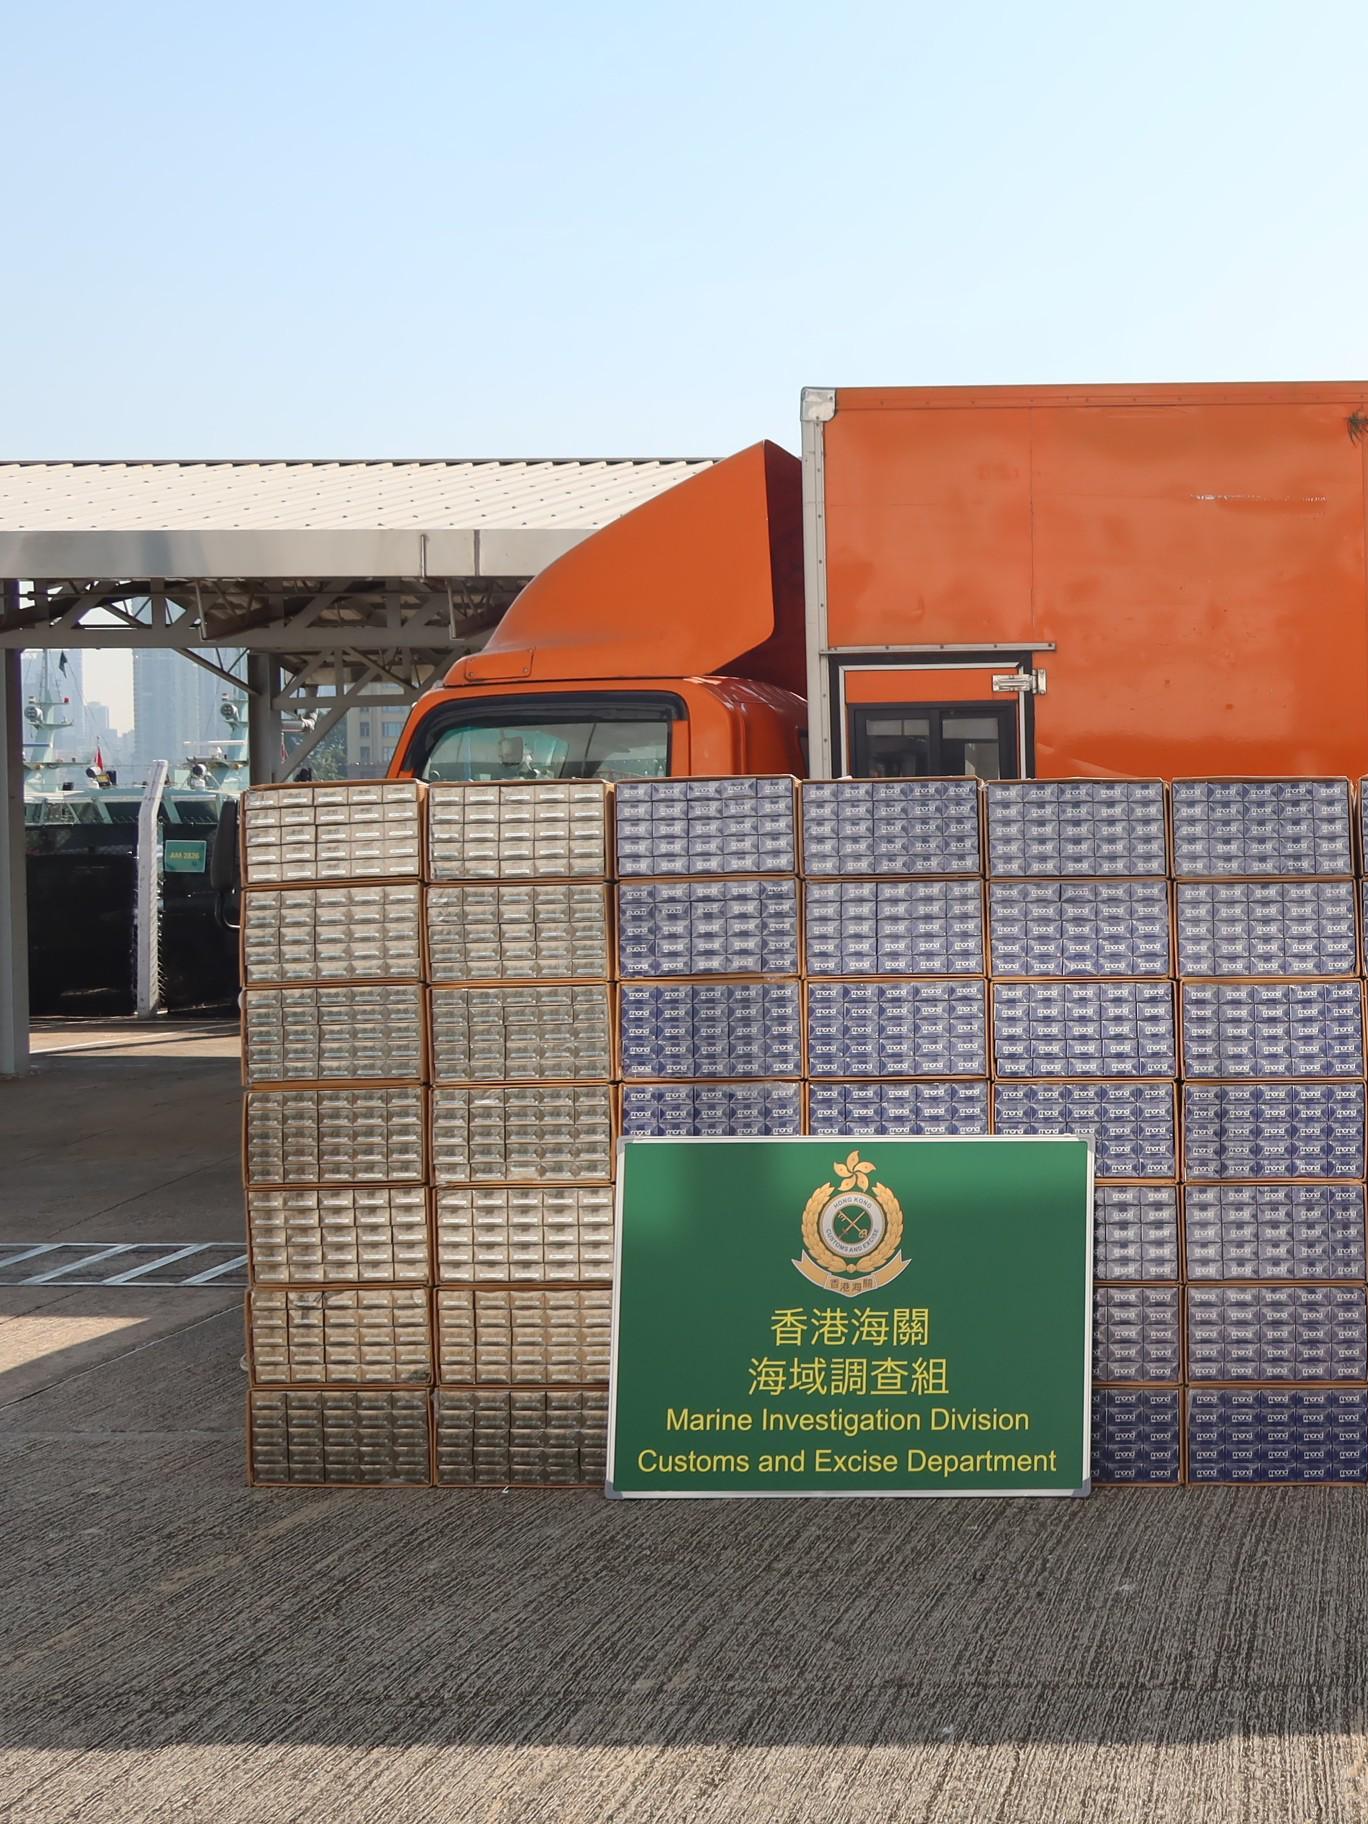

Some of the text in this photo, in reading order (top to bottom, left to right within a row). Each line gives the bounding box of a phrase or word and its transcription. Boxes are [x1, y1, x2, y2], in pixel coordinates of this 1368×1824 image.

[1221, 925, 1242, 933] mond
[919, 941, 940, 949] mond
[920, 960, 941, 968] mond
[1226, 990, 1247, 998] mond
[629, 1009, 650, 1017] mond
[816, 1007, 837, 1015] mond
[816, 1026, 837, 1034] mond
[1002, 1026, 1023, 1034] mond
[1109, 1025, 1130, 1033] mond
[816, 1044, 837, 1052] mond
[1110, 1044, 1131, 1052] mond
[1227, 1045, 1248, 1053] mond
[1300, 1063, 1321, 1071] mond
[852, 1089, 873, 1097] mond
[1038, 1090, 1059, 1098] mond
[1335, 1090, 1356, 1098] mond
[701, 1109, 722, 1117] mond
[817, 1108, 838, 1116] mond
[1336, 1108, 1357, 1116] mond
[1110, 1145, 1131, 1153] mond
[1335, 1145, 1356, 1153] mond
[825, 1228, 849, 1252] CUSTOMS
[1338, 1311, 1359, 1319] mond
[771, 1307, 929, 1346] 香港海關
[748, 1357, 949, 1396] 海域調查組
[667, 1407, 1029, 1437] Marine Investigation Division
[1232, 1450, 1253, 1458] mond
[1303, 1450, 1324, 1458] mond
[638, 1449, 1057, 1478] Customs and Excise Department
